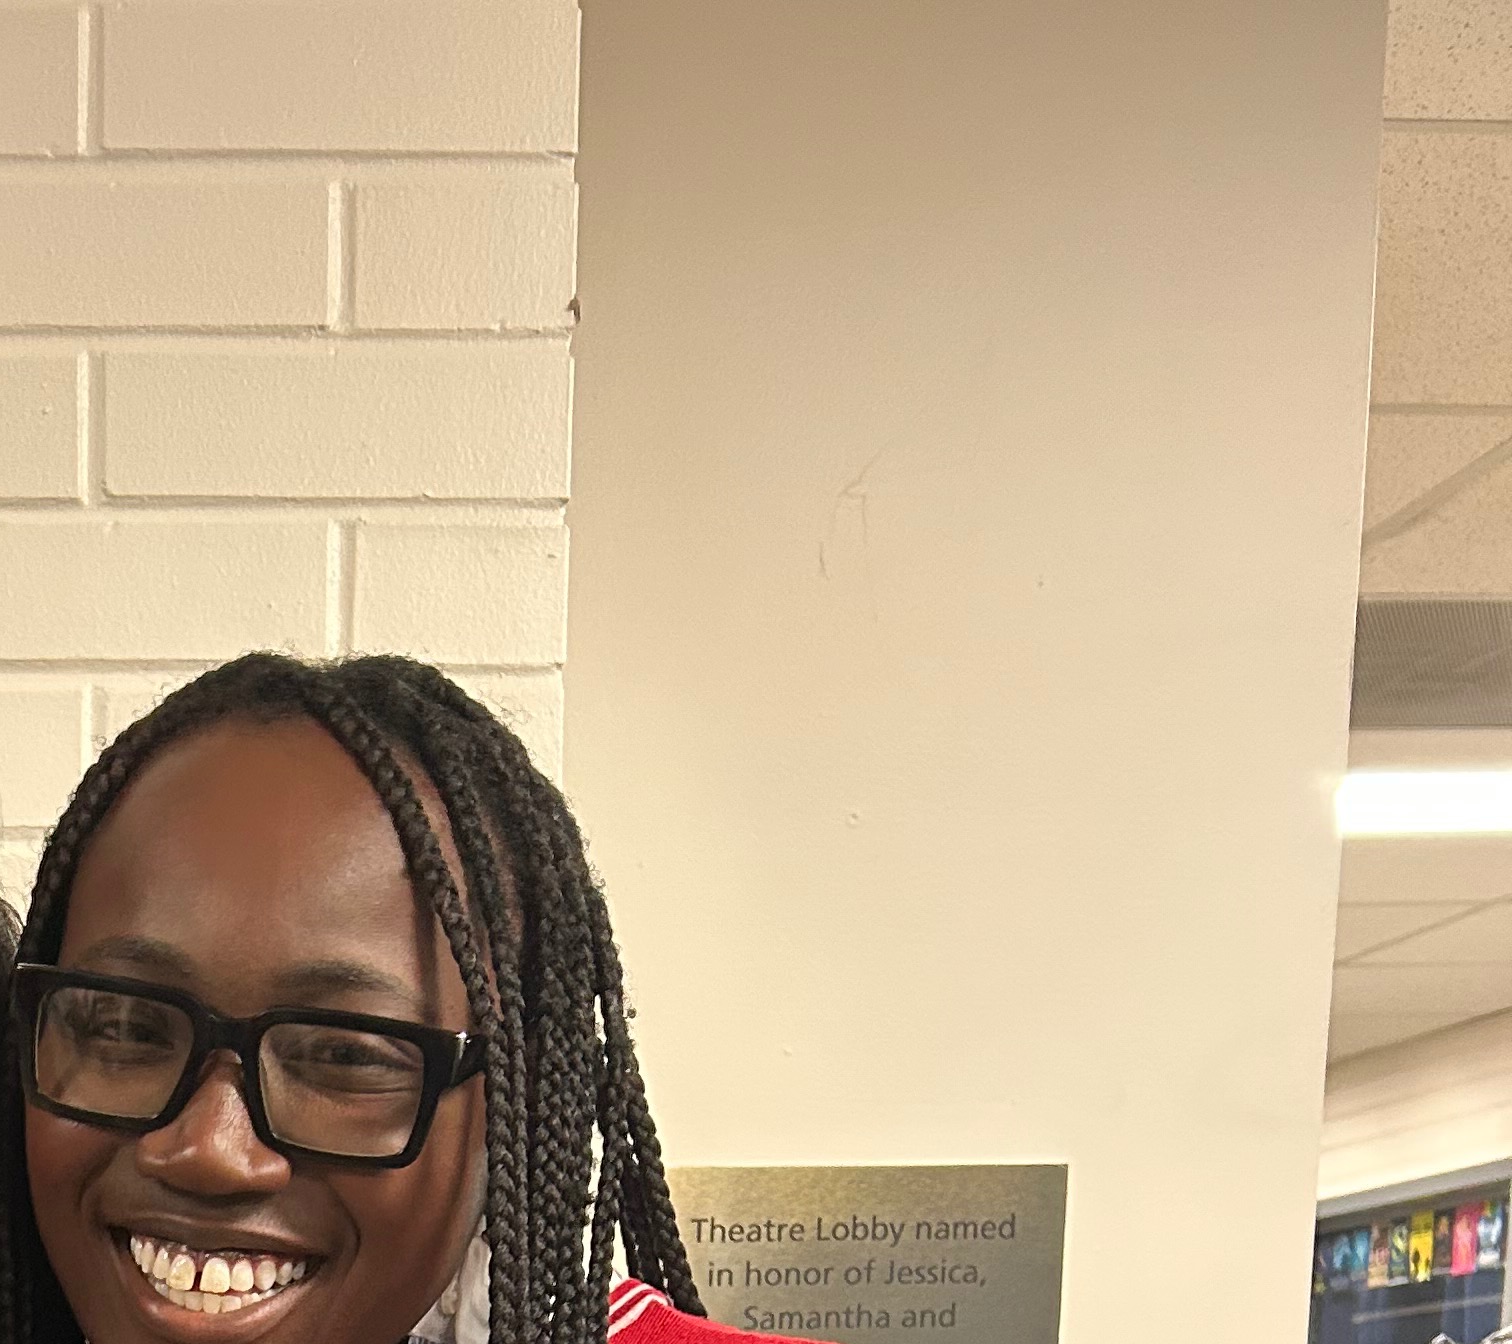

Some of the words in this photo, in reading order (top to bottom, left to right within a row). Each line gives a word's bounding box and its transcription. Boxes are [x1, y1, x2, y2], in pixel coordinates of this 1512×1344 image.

[690, 1215, 804, 1243] Theatre
[816, 1215, 904, 1245] Lobby
[915, 1214, 1015, 1239] named
[708, 1261, 733, 1287] in
[745, 1260, 833, 1287] honor
[844, 1259, 874, 1285] of
[885, 1259, 984, 1285] Jessica,
[743, 1303, 891, 1331] Samantha
[901, 1302, 956, 1327] and
